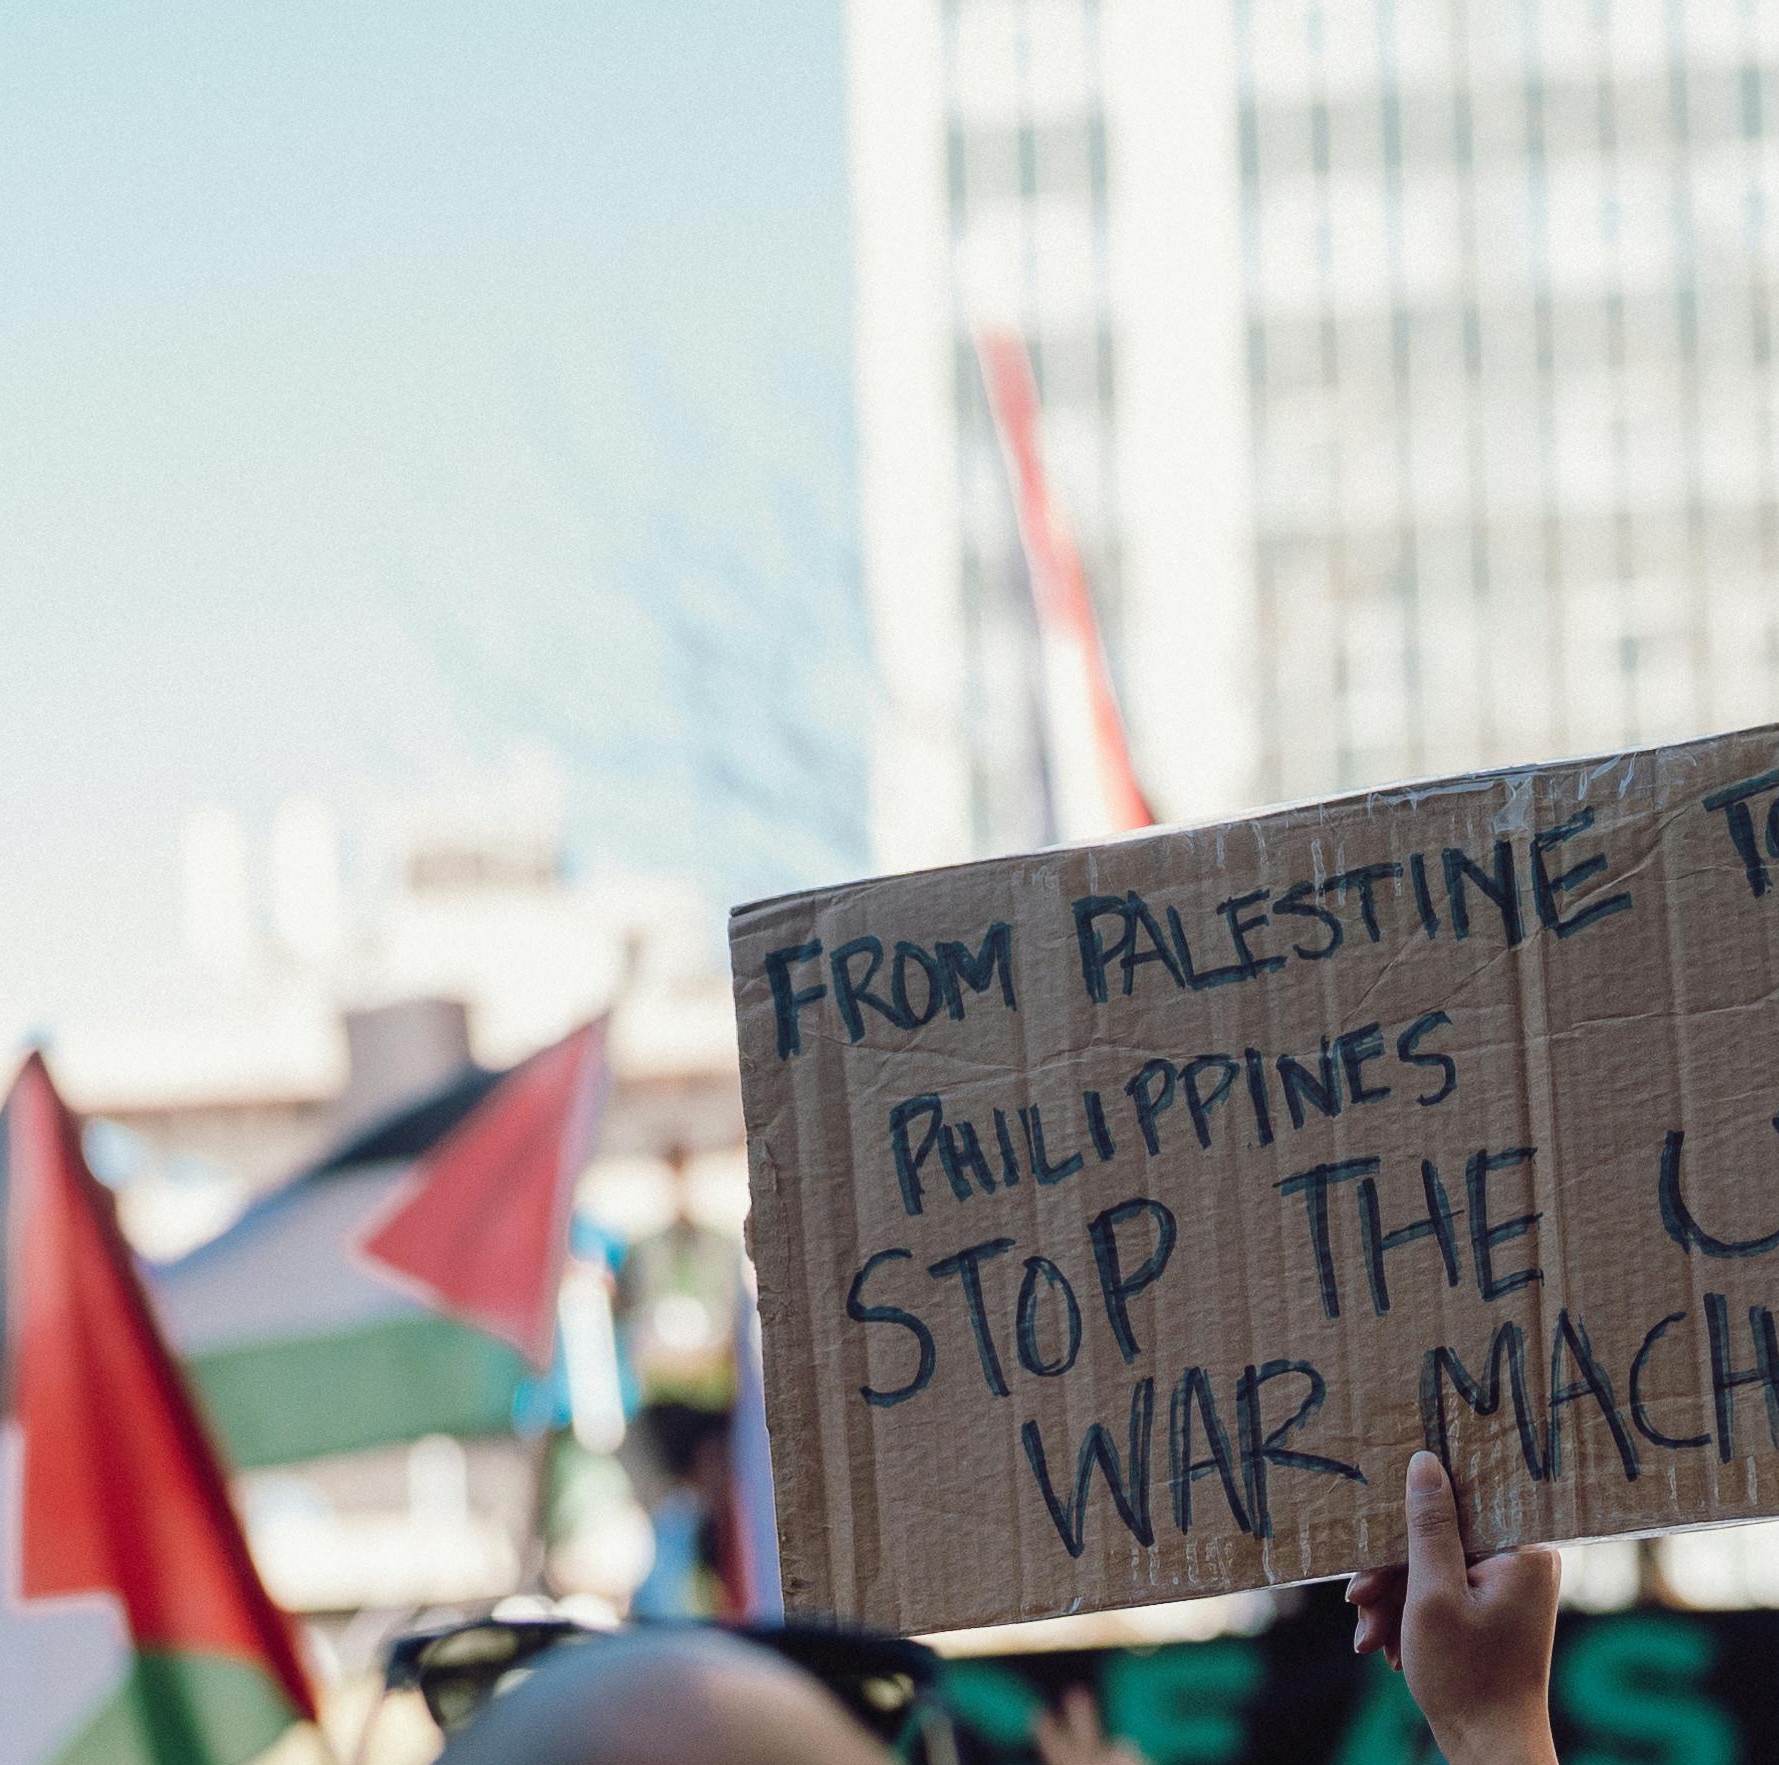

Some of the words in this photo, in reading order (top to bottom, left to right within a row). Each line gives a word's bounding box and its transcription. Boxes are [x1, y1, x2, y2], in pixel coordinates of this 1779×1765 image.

[763, 920, 1018, 1061] FROM
[1071, 806, 1633, 1004] PALESTINE
[888, 1010, 1459, 1217] PHILIPPINES
[845, 1197, 1177, 1409] STOP
[1272, 1145, 1545, 1320] THE
[1021, 1357, 1369, 1560] WAR
